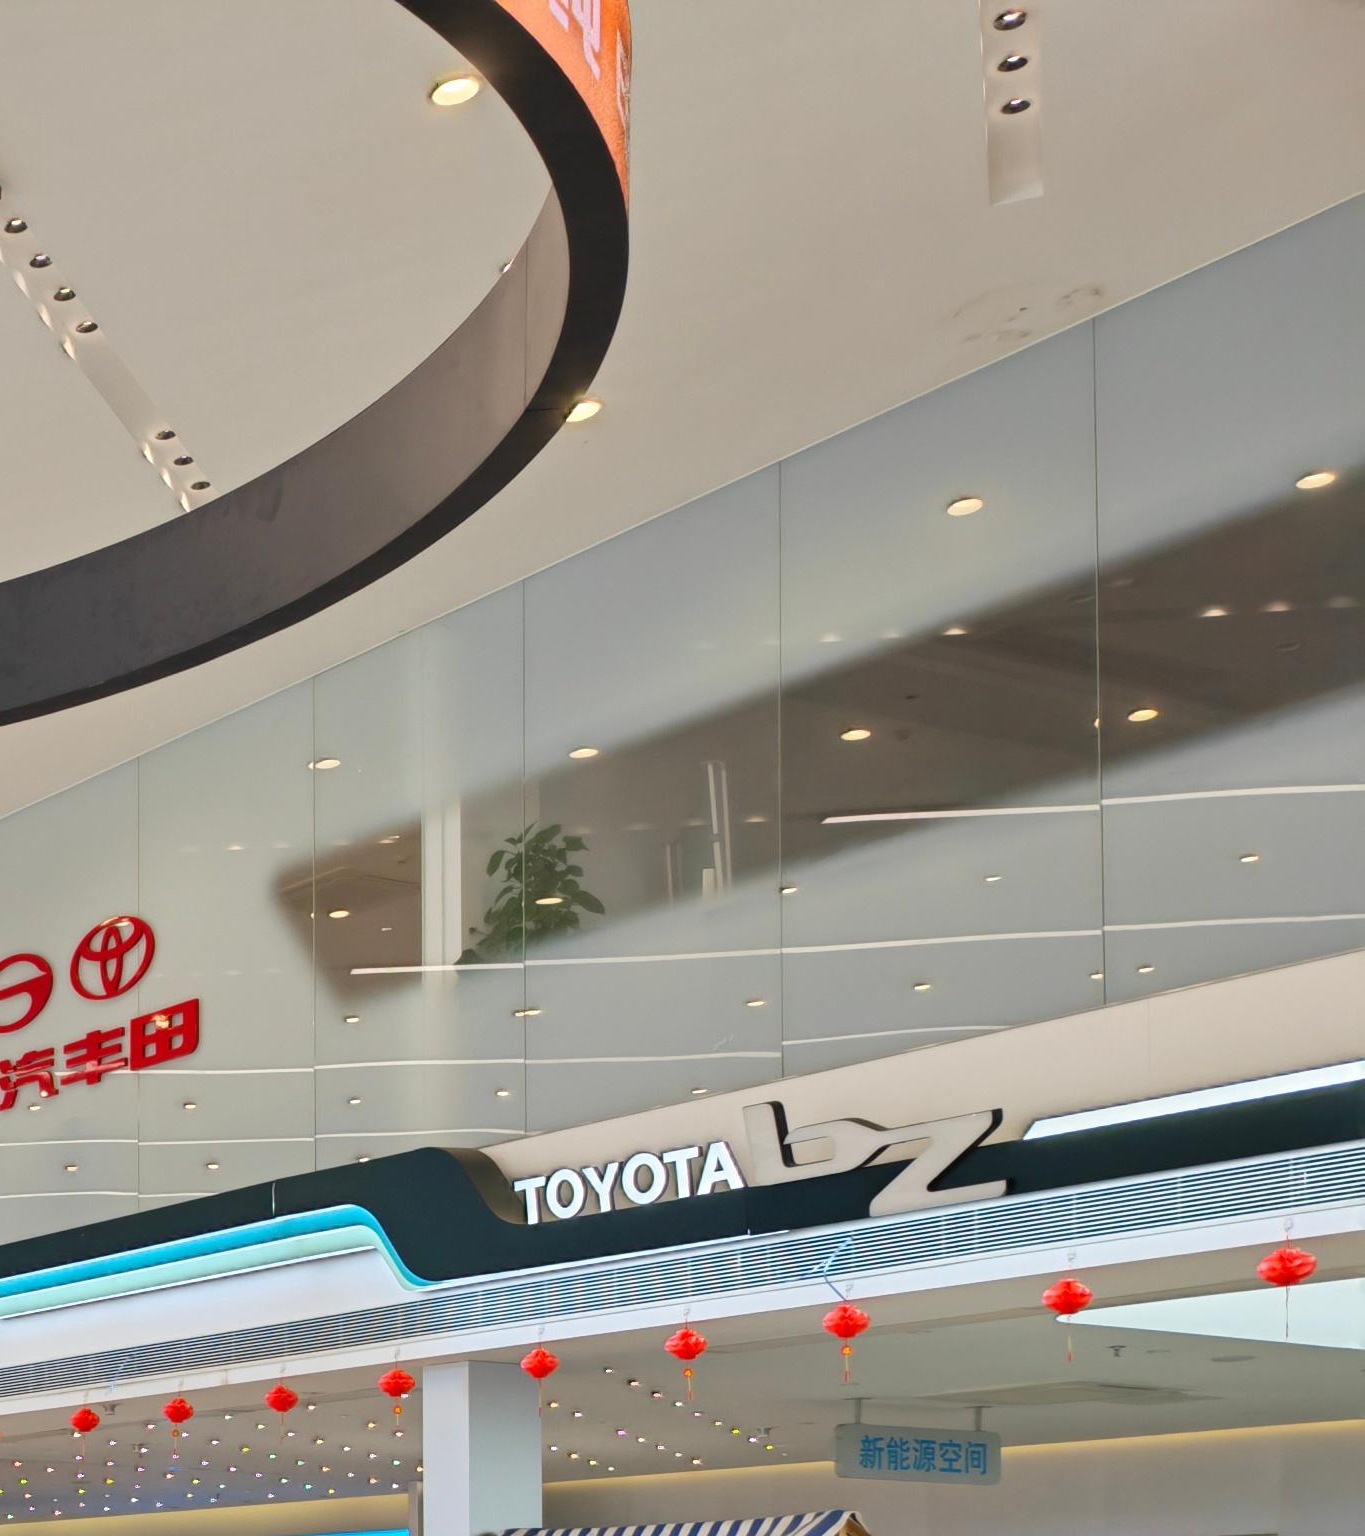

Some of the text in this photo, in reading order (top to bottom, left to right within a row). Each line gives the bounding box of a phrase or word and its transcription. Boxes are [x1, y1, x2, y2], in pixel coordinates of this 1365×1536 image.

[514, 1140, 748, 1225] TOYOTA
[859, 1435, 987, 1475] 新能源空间
